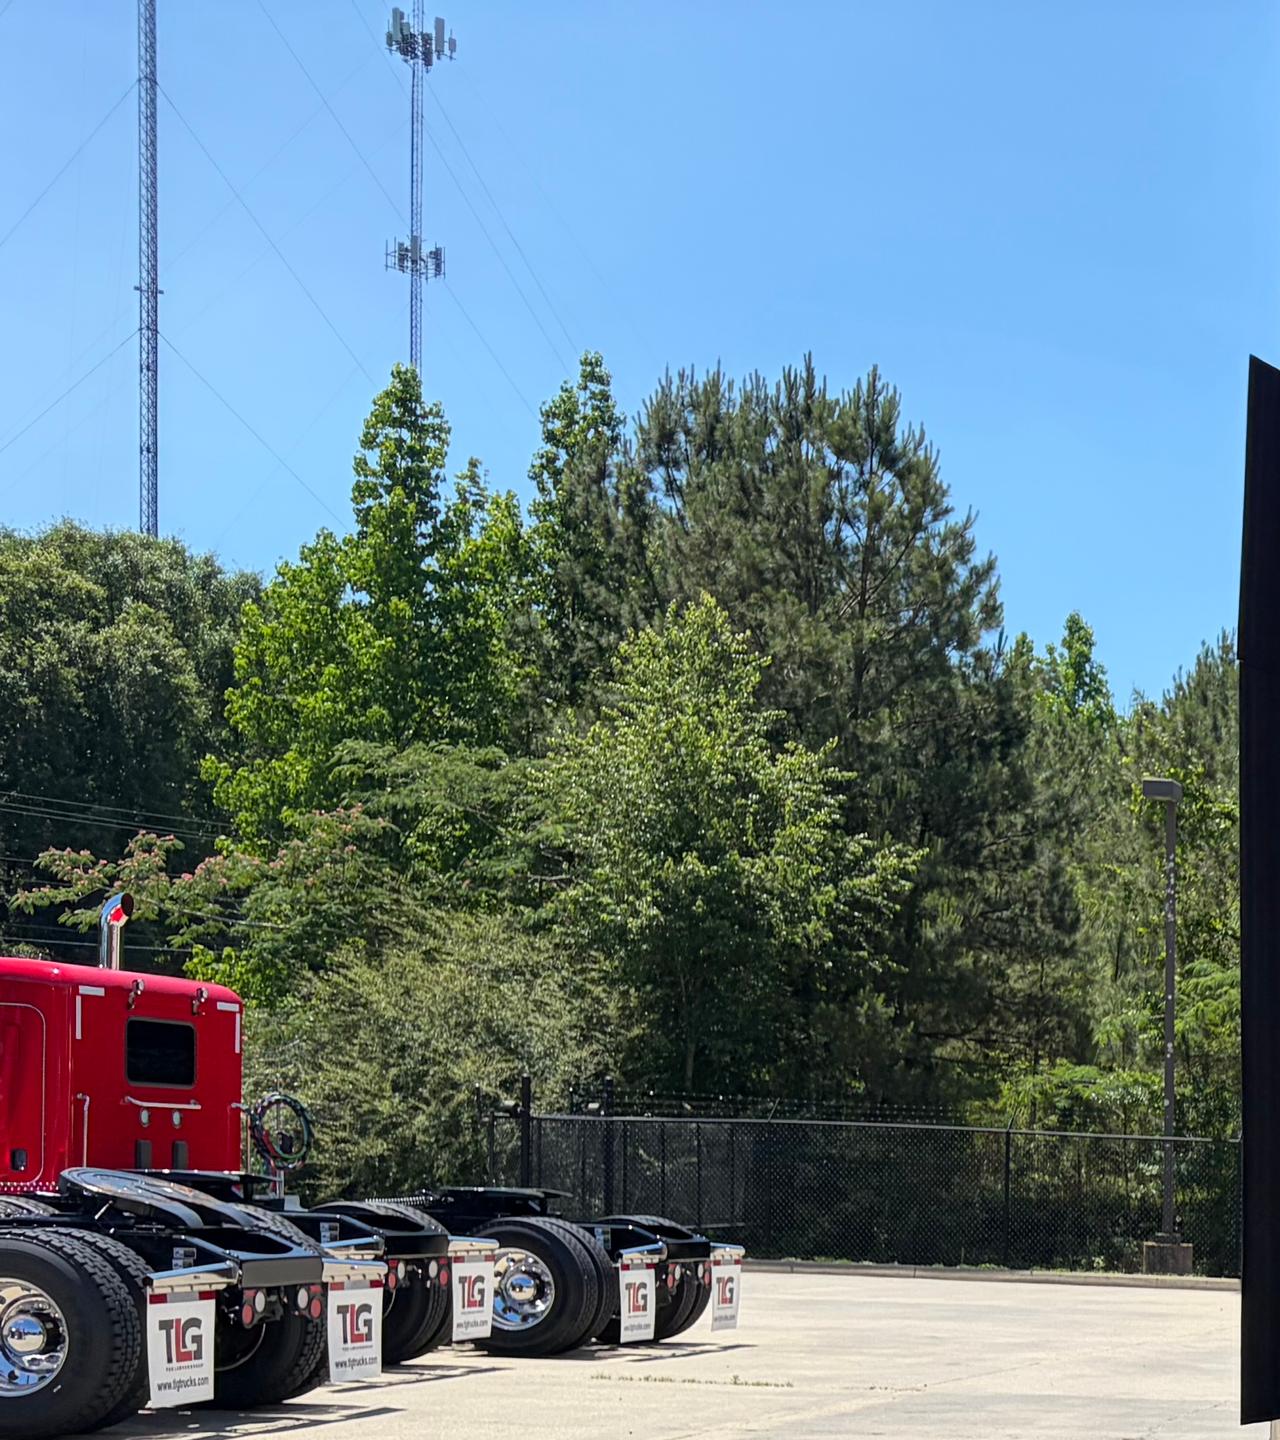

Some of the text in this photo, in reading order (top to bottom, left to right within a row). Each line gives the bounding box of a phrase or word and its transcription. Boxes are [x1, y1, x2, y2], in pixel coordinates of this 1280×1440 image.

[458, 1275, 486, 1310] TLG
[625, 1281, 648, 1314] TLG
[715, 1276, 735, 1306] TLG
[158, 1317, 204, 1364] TLG
[336, 1303, 374, 1345] TLG
